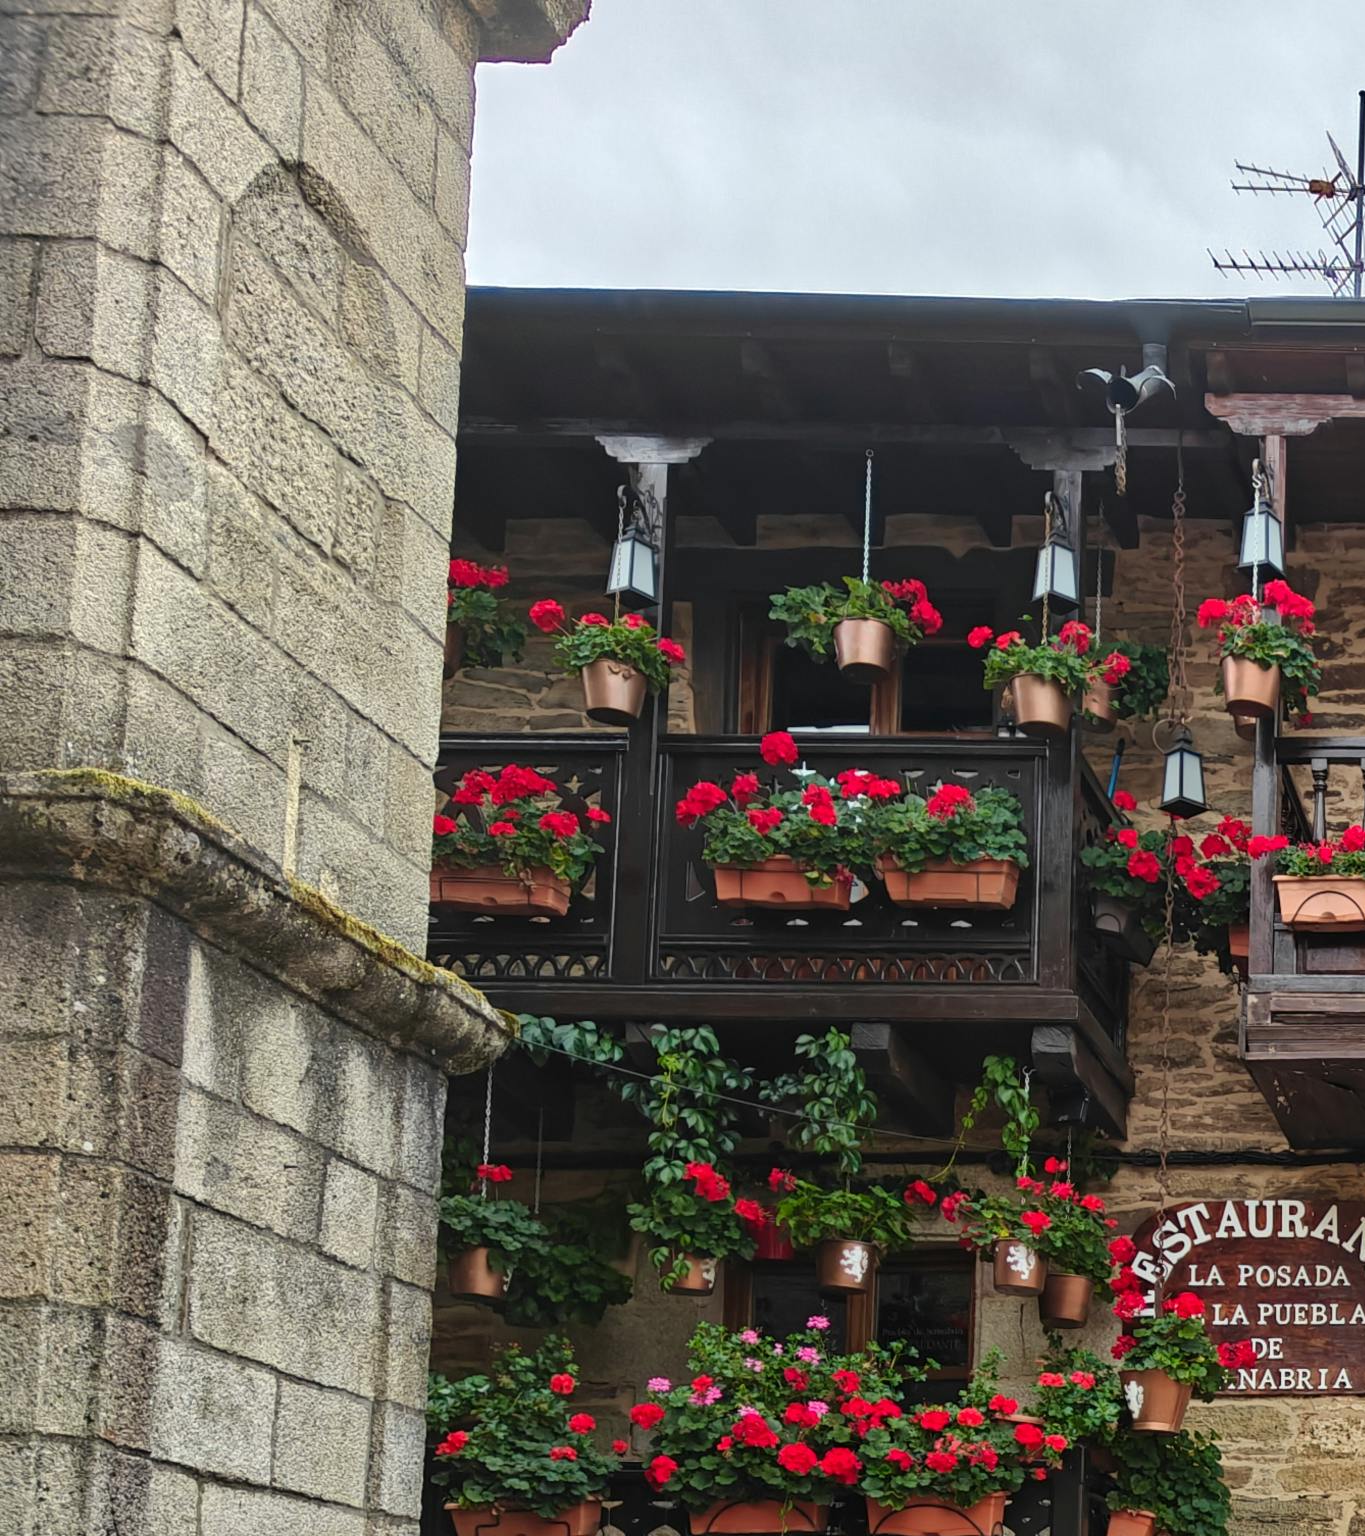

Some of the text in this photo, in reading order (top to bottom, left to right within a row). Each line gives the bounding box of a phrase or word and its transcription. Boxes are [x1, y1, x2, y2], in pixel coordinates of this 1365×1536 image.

[1188, 1265, 1350, 1286] LA POSADA
[1213, 1304, 1249, 1325] LA
[1251, 1338, 1283, 1359] DE
[1227, 1368, 1352, 1390] NABRIA
